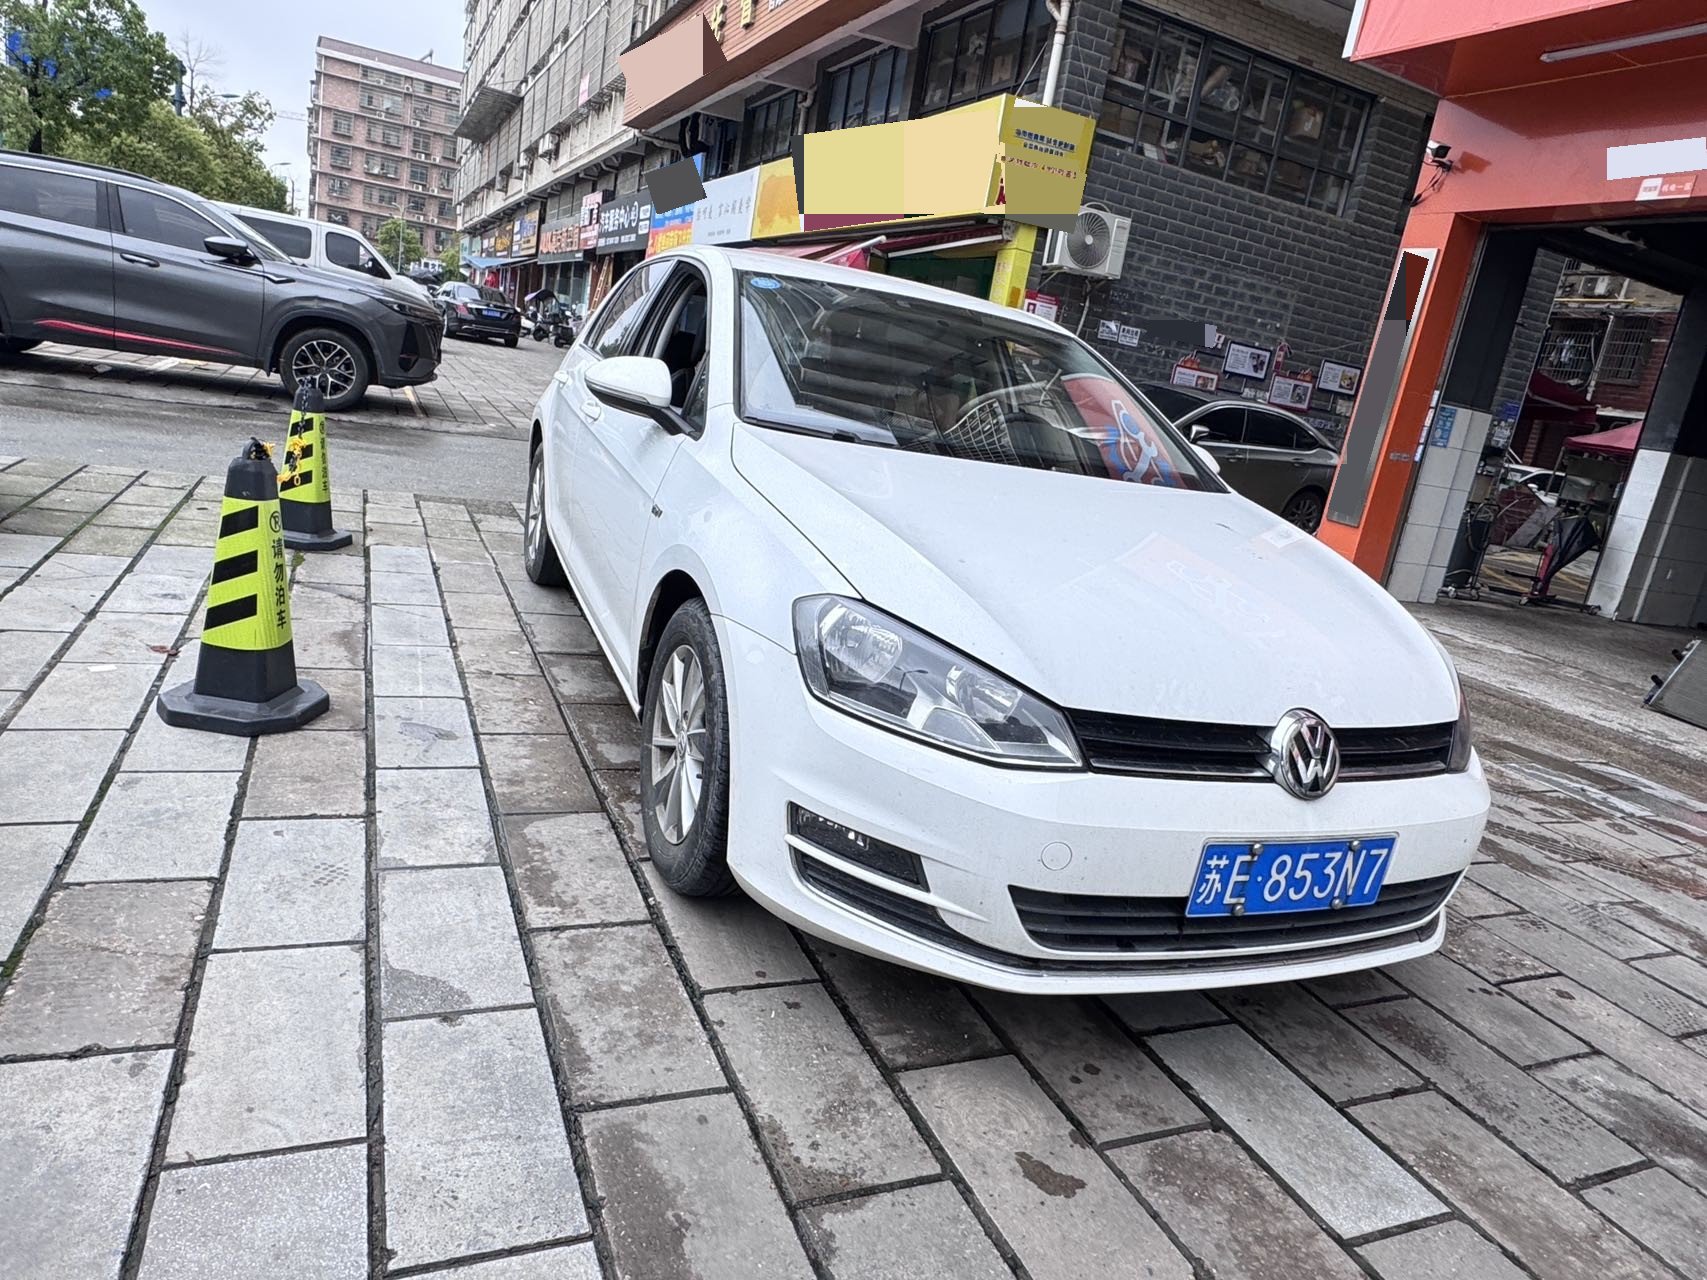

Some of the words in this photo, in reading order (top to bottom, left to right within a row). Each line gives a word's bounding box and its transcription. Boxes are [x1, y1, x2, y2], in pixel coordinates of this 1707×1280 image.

[272, 538, 287, 630] 请勿泊车
[1196, 847, 1389, 905] 苏E·853N7
